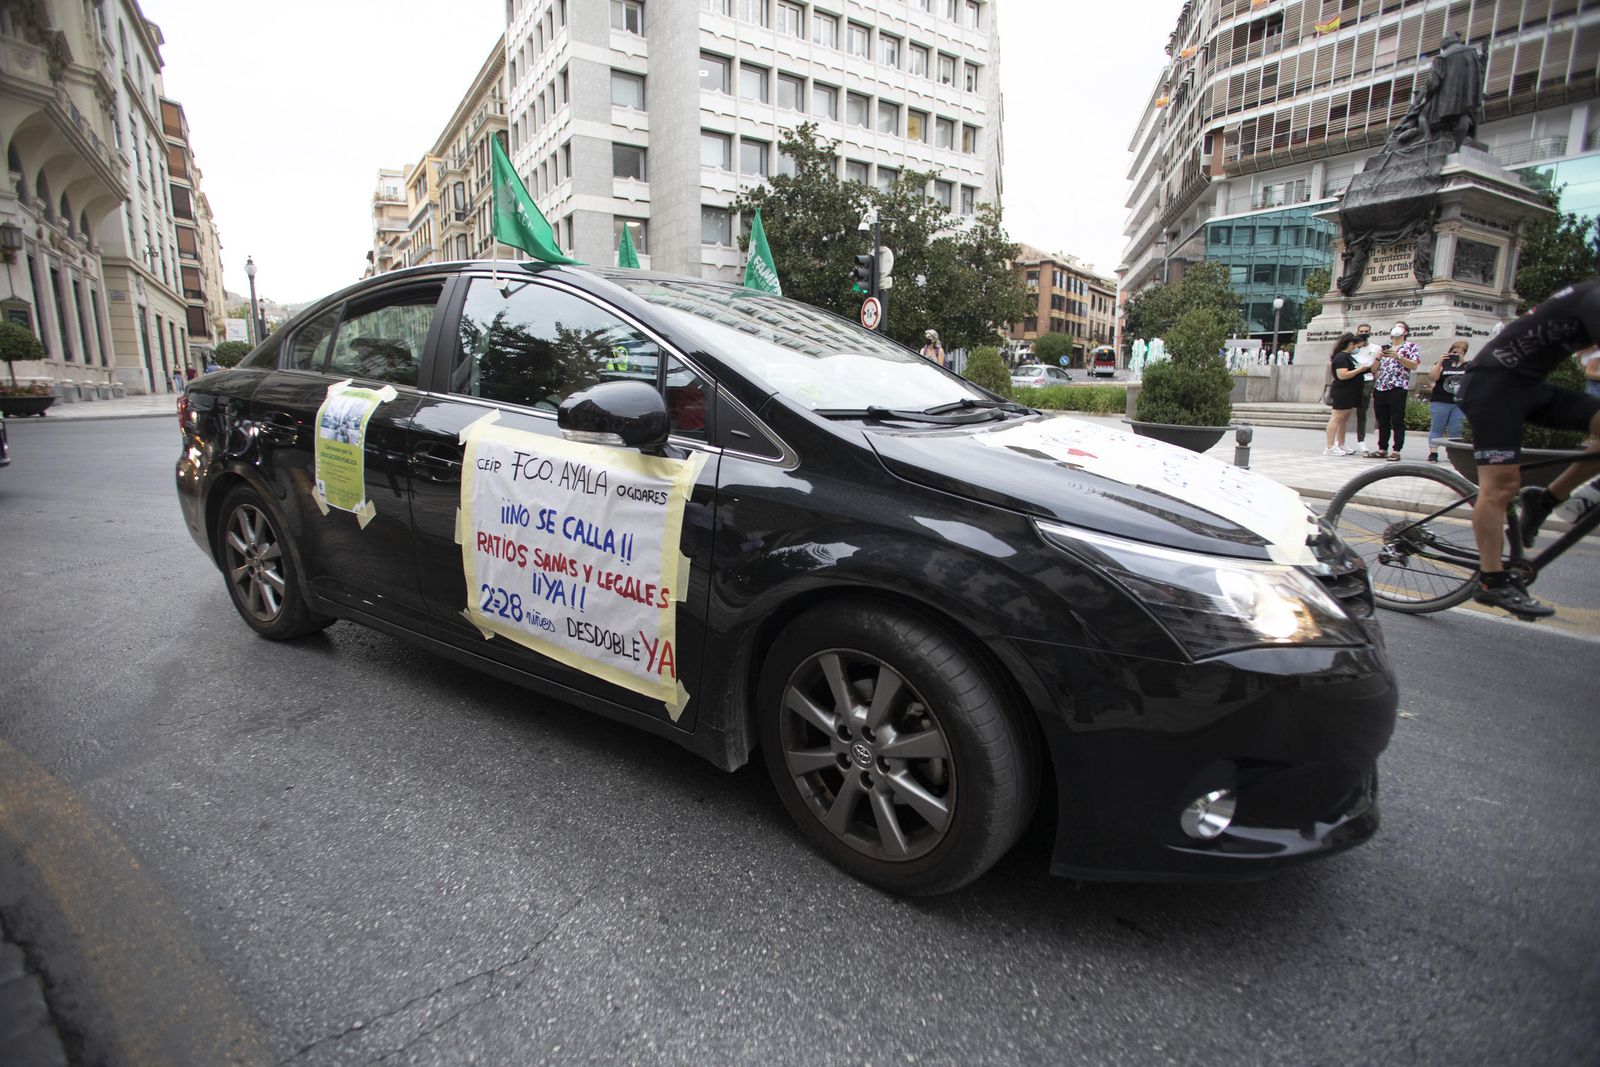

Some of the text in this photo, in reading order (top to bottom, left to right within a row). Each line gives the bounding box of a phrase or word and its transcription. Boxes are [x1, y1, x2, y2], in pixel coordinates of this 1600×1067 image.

[558, 461, 608, 497] AYALA
[535, 508, 557, 534] SE
[477, 531, 670, 609] RATIOS SANAS Y LEGALES
[566, 616, 640, 662] DESDOBLE
